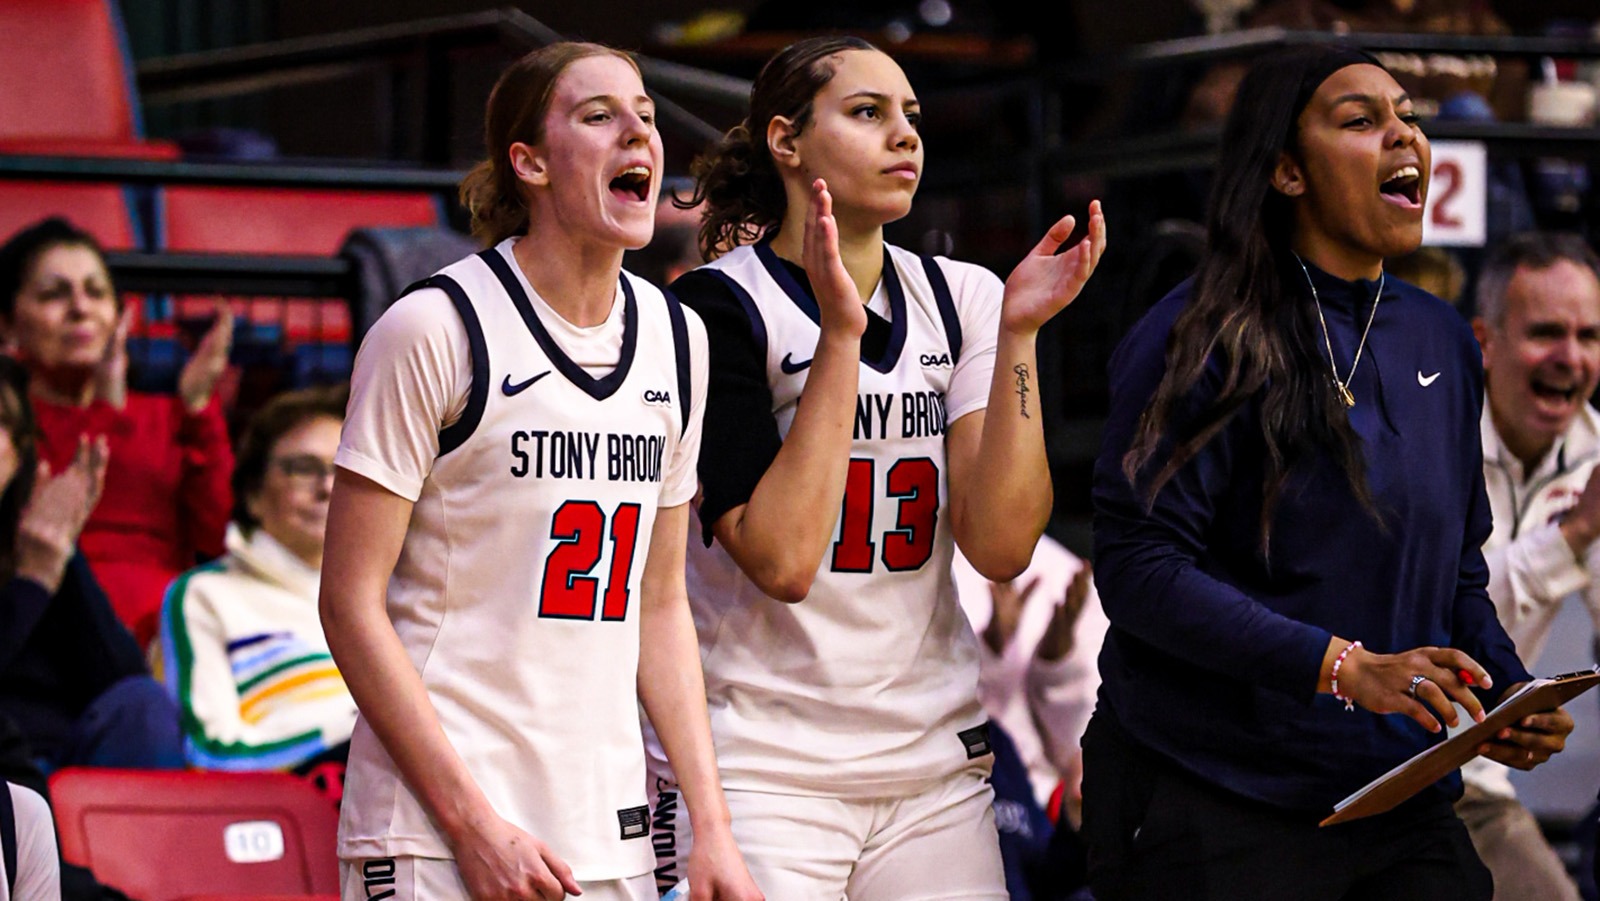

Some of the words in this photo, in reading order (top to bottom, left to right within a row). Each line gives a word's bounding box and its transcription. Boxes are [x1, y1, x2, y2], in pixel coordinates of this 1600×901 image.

[919, 353, 951, 367] CAA
[643, 390, 672, 405] CAA
[901, 391, 948, 439] BROO
[510, 430, 601, 481] STONY
[607, 433, 666, 483] BROOK
[830, 456, 940, 574] 13
[538, 498, 642, 622] 21
[237, 831, 272, 856] 10
